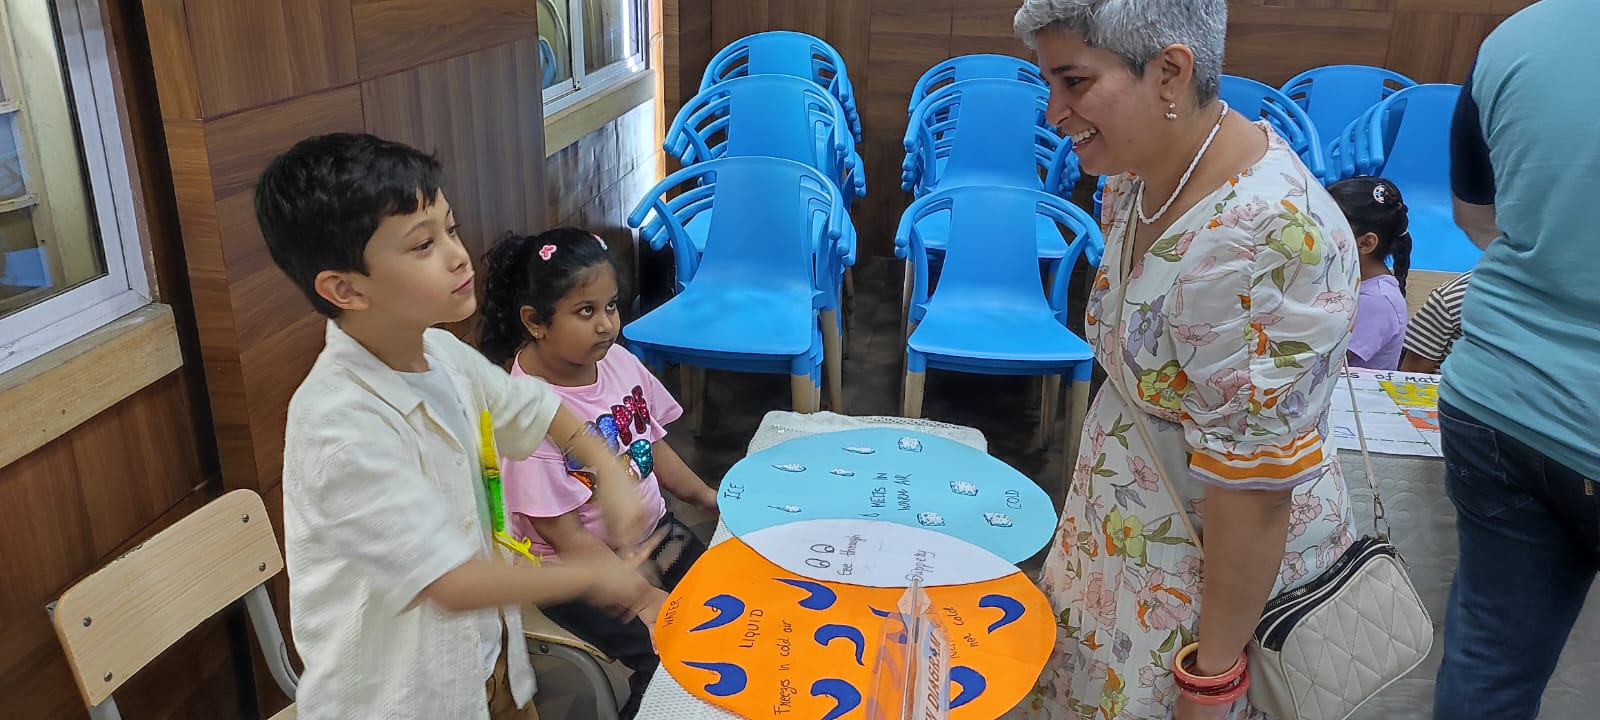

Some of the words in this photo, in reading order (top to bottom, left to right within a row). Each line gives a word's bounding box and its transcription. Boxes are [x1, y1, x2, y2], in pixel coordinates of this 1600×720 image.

[723, 482, 744, 500] ICE
[1004, 489, 1022, 509] COLD
[738, 609, 764, 648] LIQUID
